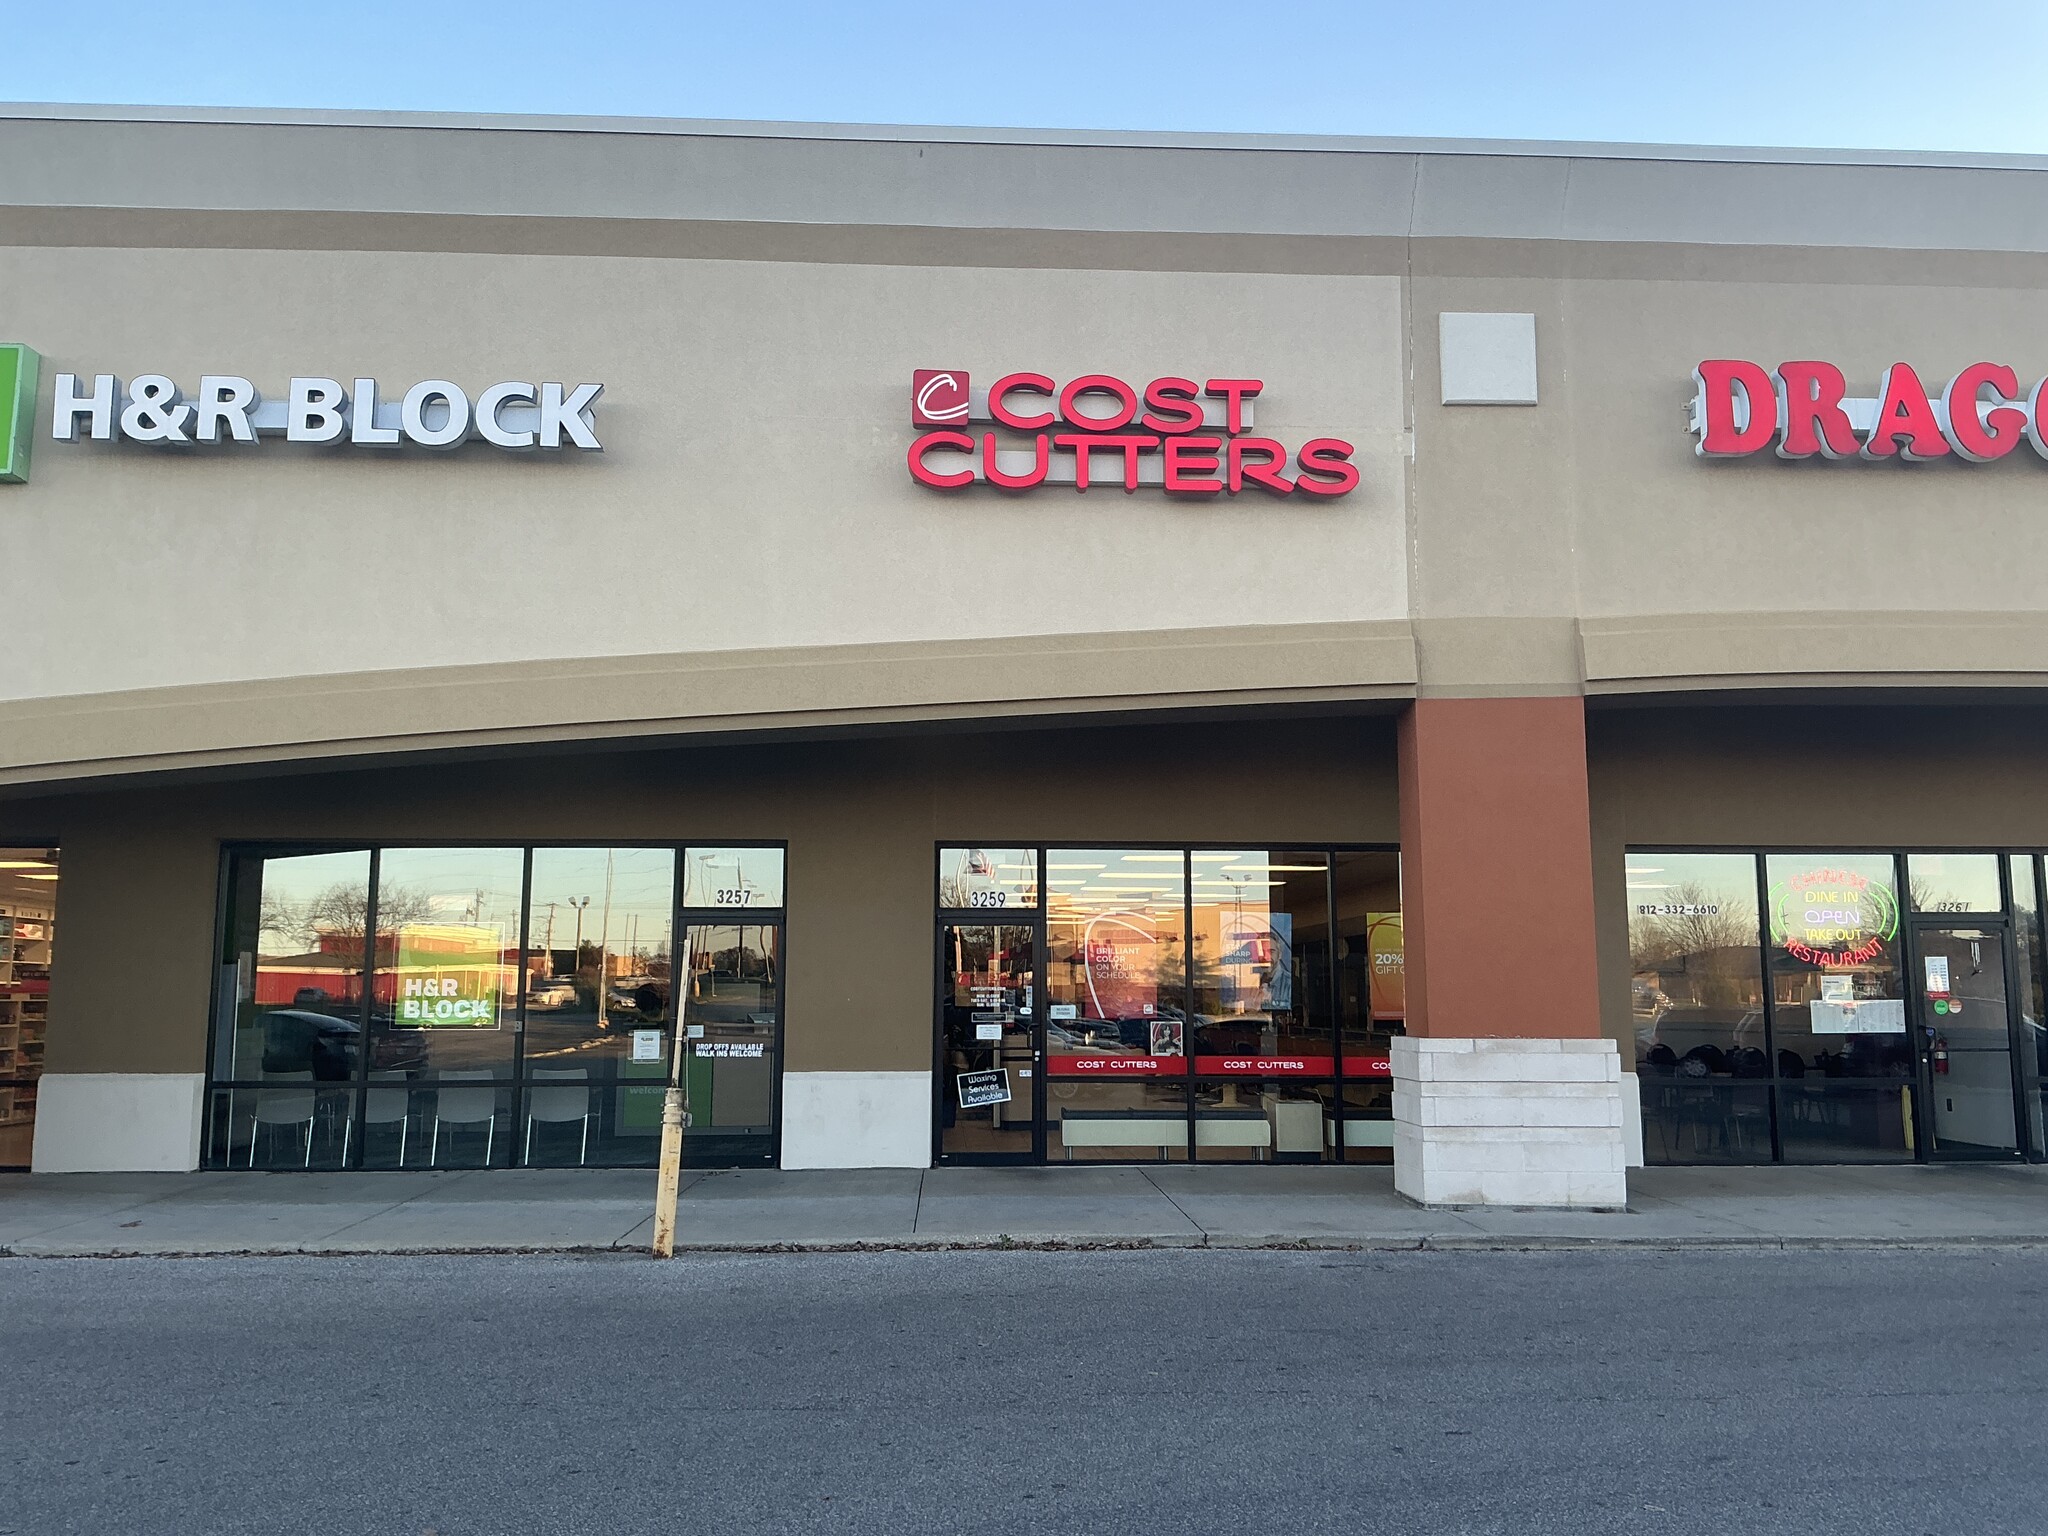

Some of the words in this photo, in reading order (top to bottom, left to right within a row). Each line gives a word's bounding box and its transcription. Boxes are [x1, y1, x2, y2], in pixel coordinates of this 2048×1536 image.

[988, 372, 1263, 435] COST
[1696, 360, 2048, 458] DRAG
[52, 372, 259, 444] H&R
[286, 376, 604, 451] BLOCK
[907, 431, 1360, 496] CUTTERS
[717, 889, 751, 904] 3257
[971, 891, 1006, 907] 3259
[1805, 891, 1838, 903] DINE
[1843, 891, 1858, 903] IN
[1639, 904, 1718, 915] 812-332-6610
[1940, 902, 1970, 912] 3261
[1804, 908, 1860, 924] OPEN
[1804, 928, 1834, 941] TAKE
[1835, 928, 1862, 941] OUT
[1096, 947, 1140, 955] BRILLIANT
[1783, 936, 1884, 968] RESTAURANT
[1096, 955, 1126, 963] COLOR
[1375, 953, 1404, 965] 20%
[1096, 963, 1109, 971] ON
[1112, 963, 1135, 971] YOUR
[1376, 965, 1398, 975] GIFT
[1096, 971, 1141, 979] SCHEDULE
[405, 978, 458, 997] H&R
[404, 1000, 491, 1018] BLOCK
[696, 1043, 713, 1051] DROP
[714, 1043, 729, 1051] OFFS
[731, 1043, 764, 1051] AVAILABLE
[1076, 1061, 1106, 1069] COST
[1110, 1061, 1157, 1069] CUTTERS
[1223, 1061, 1252, 1069] COST
[1257, 1061, 1304, 1069] CUTTERS
[967, 1074, 997, 1084] Waxing
[968, 1083, 999, 1094] Services
[967, 1092, 1003, 1104] Available
